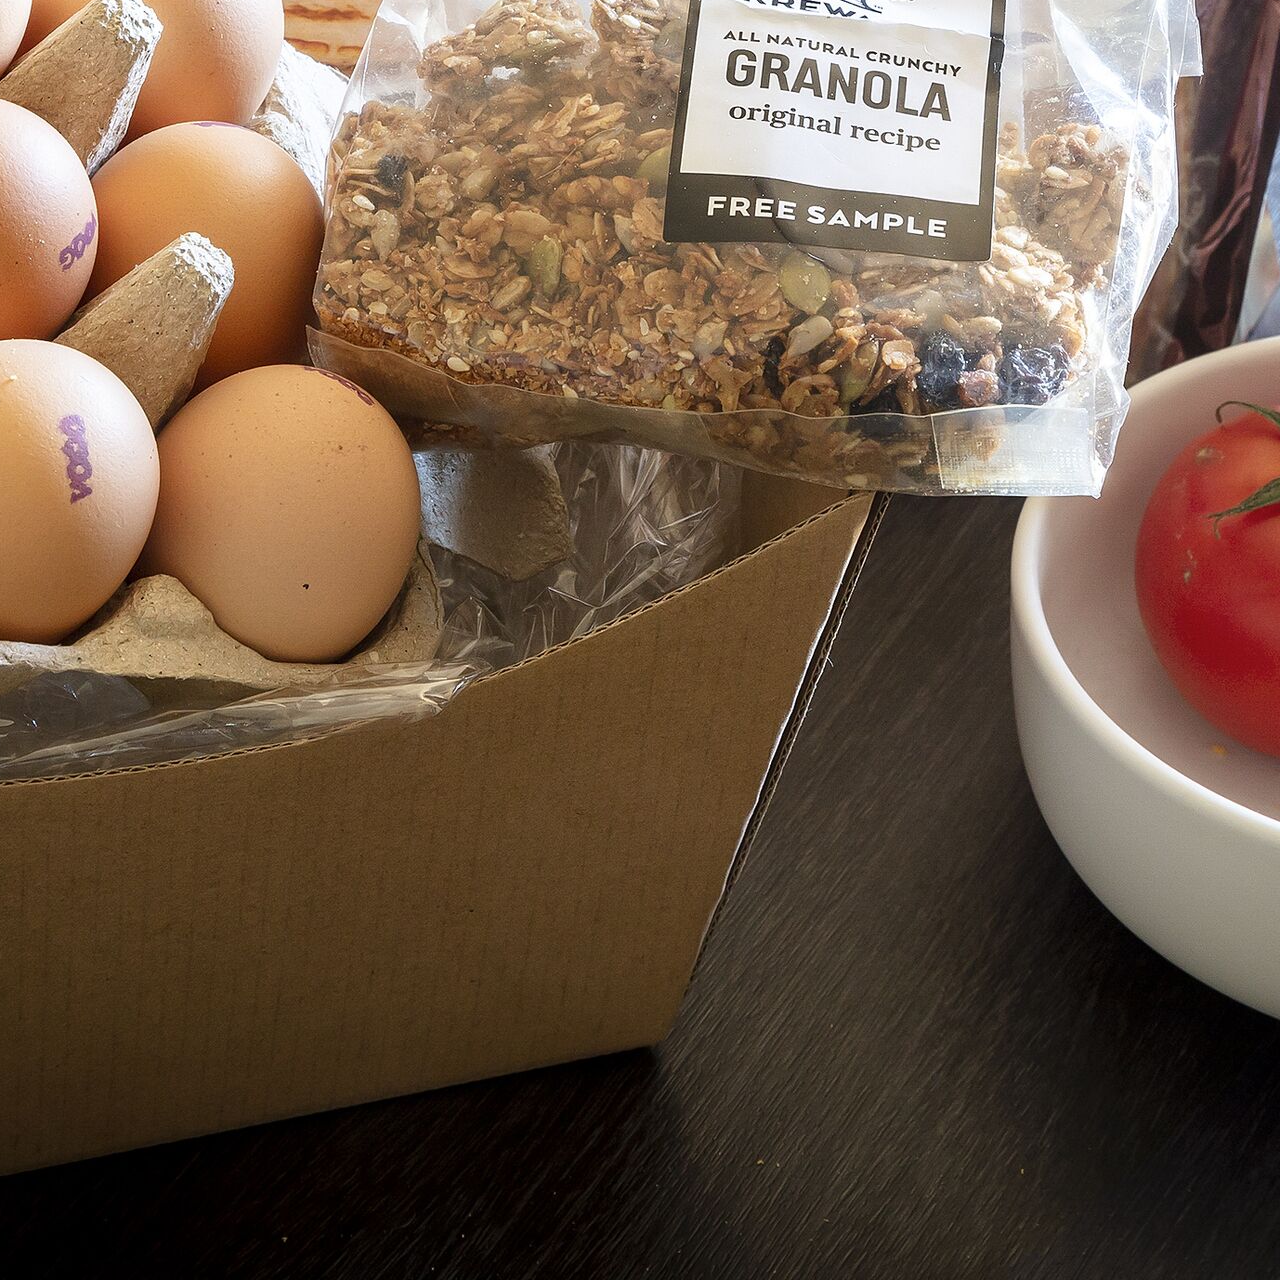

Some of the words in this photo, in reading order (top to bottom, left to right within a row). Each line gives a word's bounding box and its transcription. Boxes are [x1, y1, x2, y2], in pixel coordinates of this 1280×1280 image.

[723, 30, 761, 43] ALL
[765, 34, 860, 59] NATURAL
[865, 50, 962, 77] CRUNCHY
[724, 48, 952, 122] GRANOLA
[728, 104, 841, 137] original
[849, 124, 942, 152] recipe
[706, 196, 797, 220] FREE
[806, 206, 948, 238] SAMPLE
